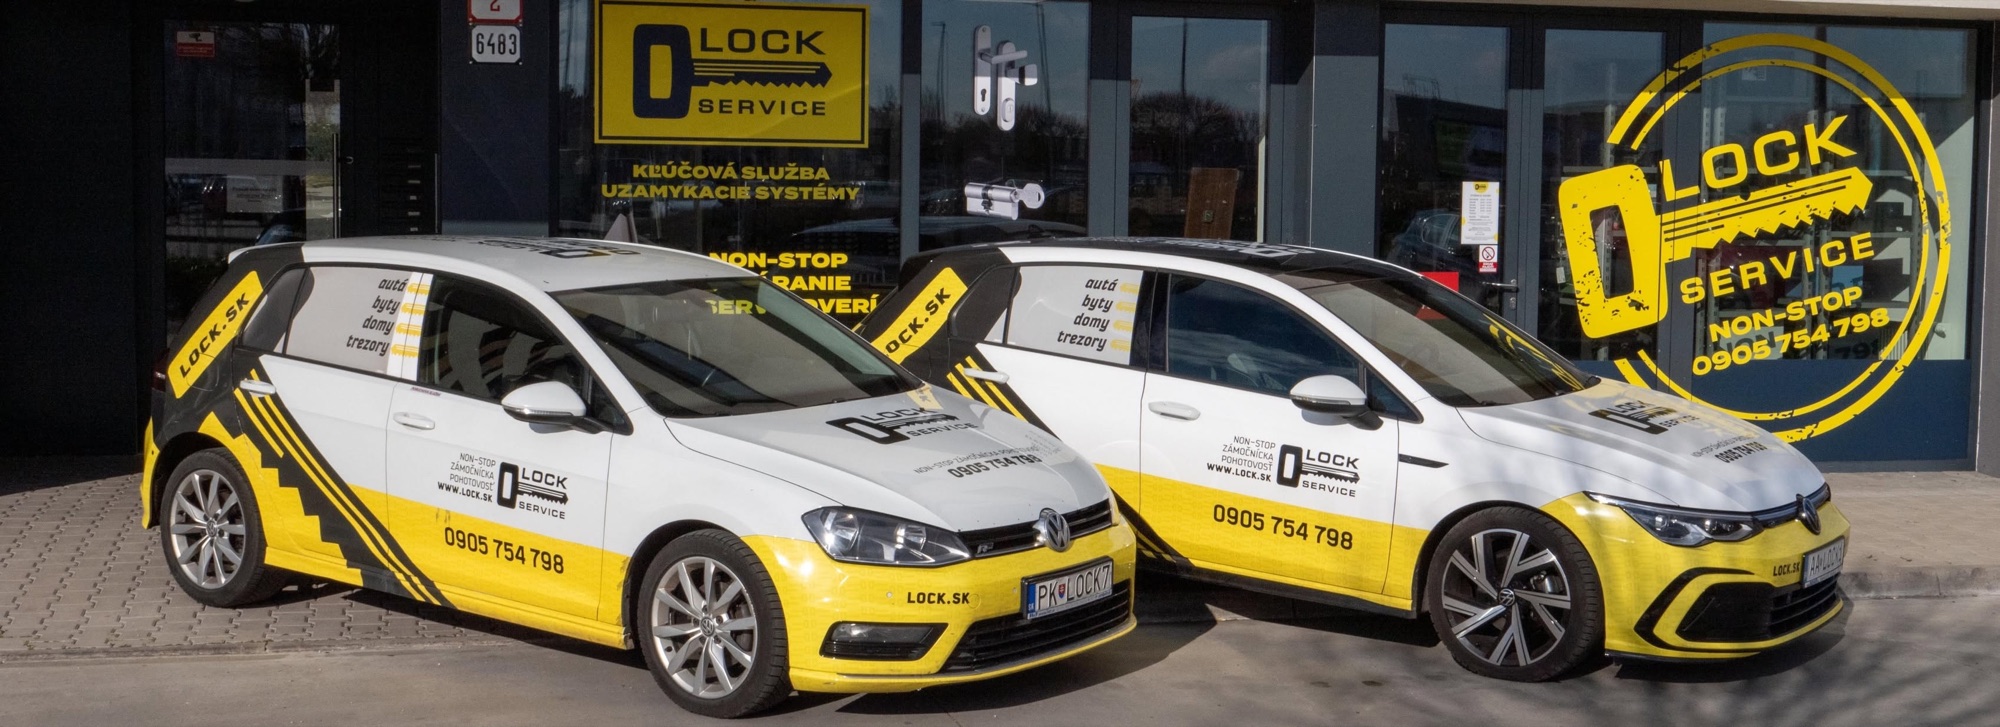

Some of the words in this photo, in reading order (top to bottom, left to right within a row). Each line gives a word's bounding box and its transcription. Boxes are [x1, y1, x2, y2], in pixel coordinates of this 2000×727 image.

[476, 33, 517, 55] 6483
[700, 28, 826, 55] LOCK
[698, 99, 826, 116] SERVICE
[1659, 114, 1858, 202] LOCK
[633, 161, 738, 180] KĽÚČOVÁ
[741, 163, 830, 181] SLUŽBA
[601, 183, 751, 199] UZAMYKACIE
[755, 183, 861, 200] SYSTÉMY
[709, 252, 848, 269] NON-STOP
[1680, 232, 1875, 304] SERVICE
[378, 278, 409, 292] autá
[1085, 278, 1119, 292] autá
[372, 295, 401, 315] byty
[1081, 294, 1114, 313] byty
[885, 287, 951, 354] OCK.SK
[1073, 312, 1110, 332] domy
[1709, 286, 1863, 342] NON-STOP
[180, 292, 250, 378] LOCK.SK
[362, 315, 395, 336] domy
[346, 335, 390, 357] trezory
[1056, 330, 1108, 352] trezory
[1692, 339, 1772, 376] 0905
[1775, 323, 1831, 354] 754
[1833, 307, 1890, 338] 798
[860, 407, 938, 422] LOCK
[906, 421, 979, 438] SERVICE
[1222, 443, 1274, 462] ZÁMOČNÍCKA
[1233, 435, 1276, 450] NON-STOP
[459, 452, 497, 468] NON-STOP
[948, 462, 991, 479] 0905
[987, 457, 1019, 470] 754
[1014, 453, 1043, 465] 798
[1306, 449, 1360, 470] LOCK
[521, 467, 569, 490] LOCK
[1206, 462, 1272, 482] WWW.LOCK.SK
[437, 481, 493, 503] WWW.LOCK.SK
[1302, 480, 1356, 498] SERVICE
[518, 501, 566, 520] SERVICE
[1213, 504, 1265, 531] 0905
[1271, 516, 1308, 541] 754
[1314, 525, 1353, 550] 798
[444, 526, 489, 555] 0905
[492, 538, 527, 565] 754
[530, 547, 565, 574] 798
[1772, 561, 1800, 577] LOCK.SK
[907, 592, 971, 605] LOCK.SK
